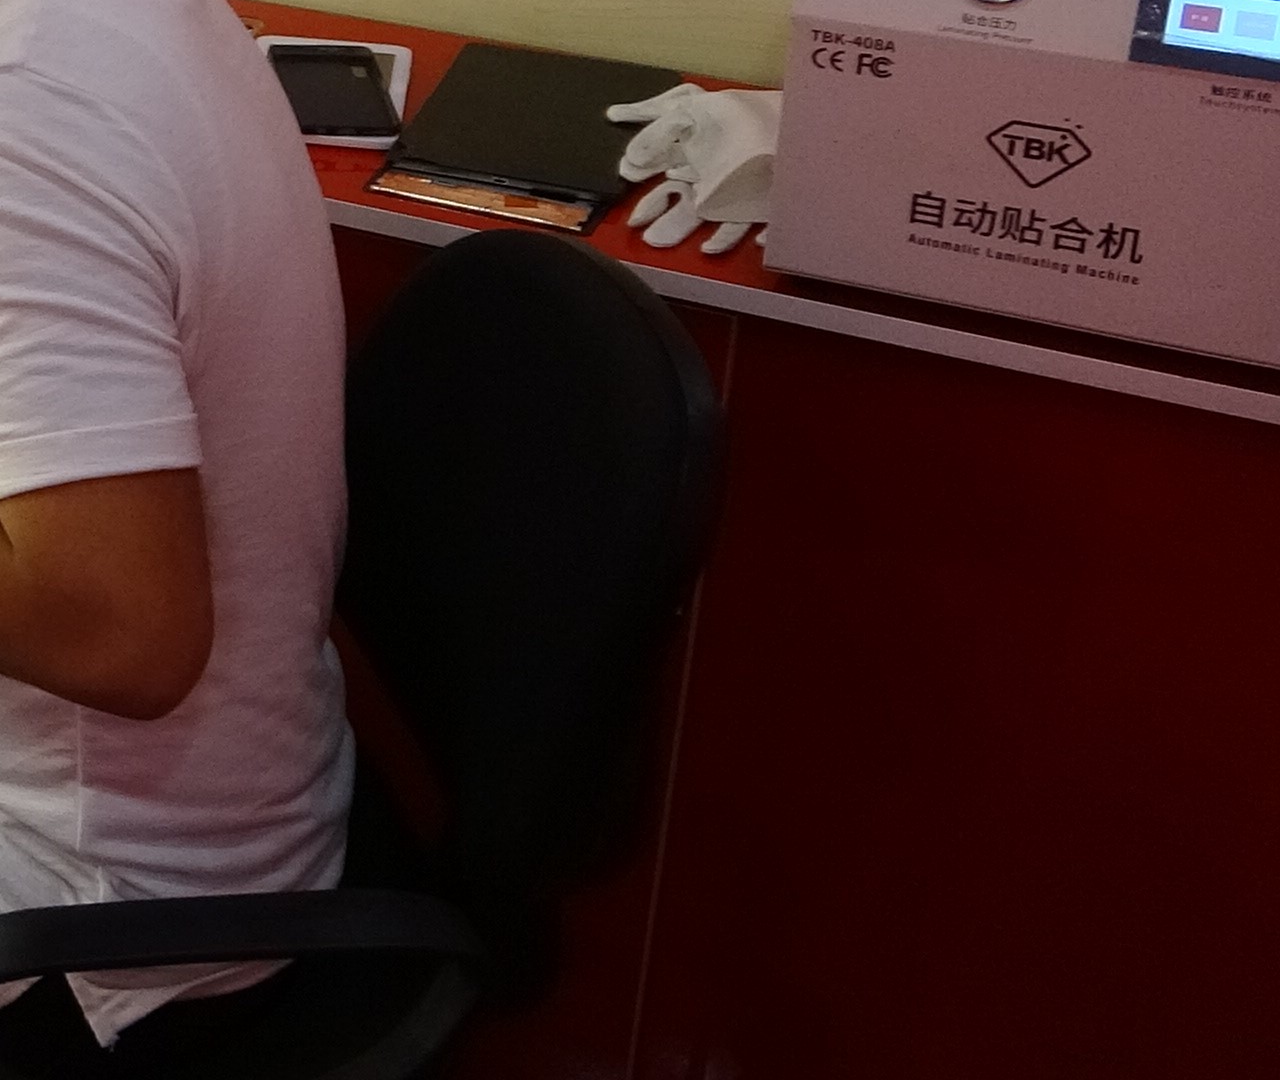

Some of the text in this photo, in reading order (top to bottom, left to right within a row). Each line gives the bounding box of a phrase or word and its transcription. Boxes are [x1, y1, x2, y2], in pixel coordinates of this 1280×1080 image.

[811, 29, 895, 53] TBK-408A
[1001, 133, 1071, 166] TBK
[909, 191, 1144, 264] 自动贴合机
[907, 233, 1140, 286] Automatic Laminating Machine
